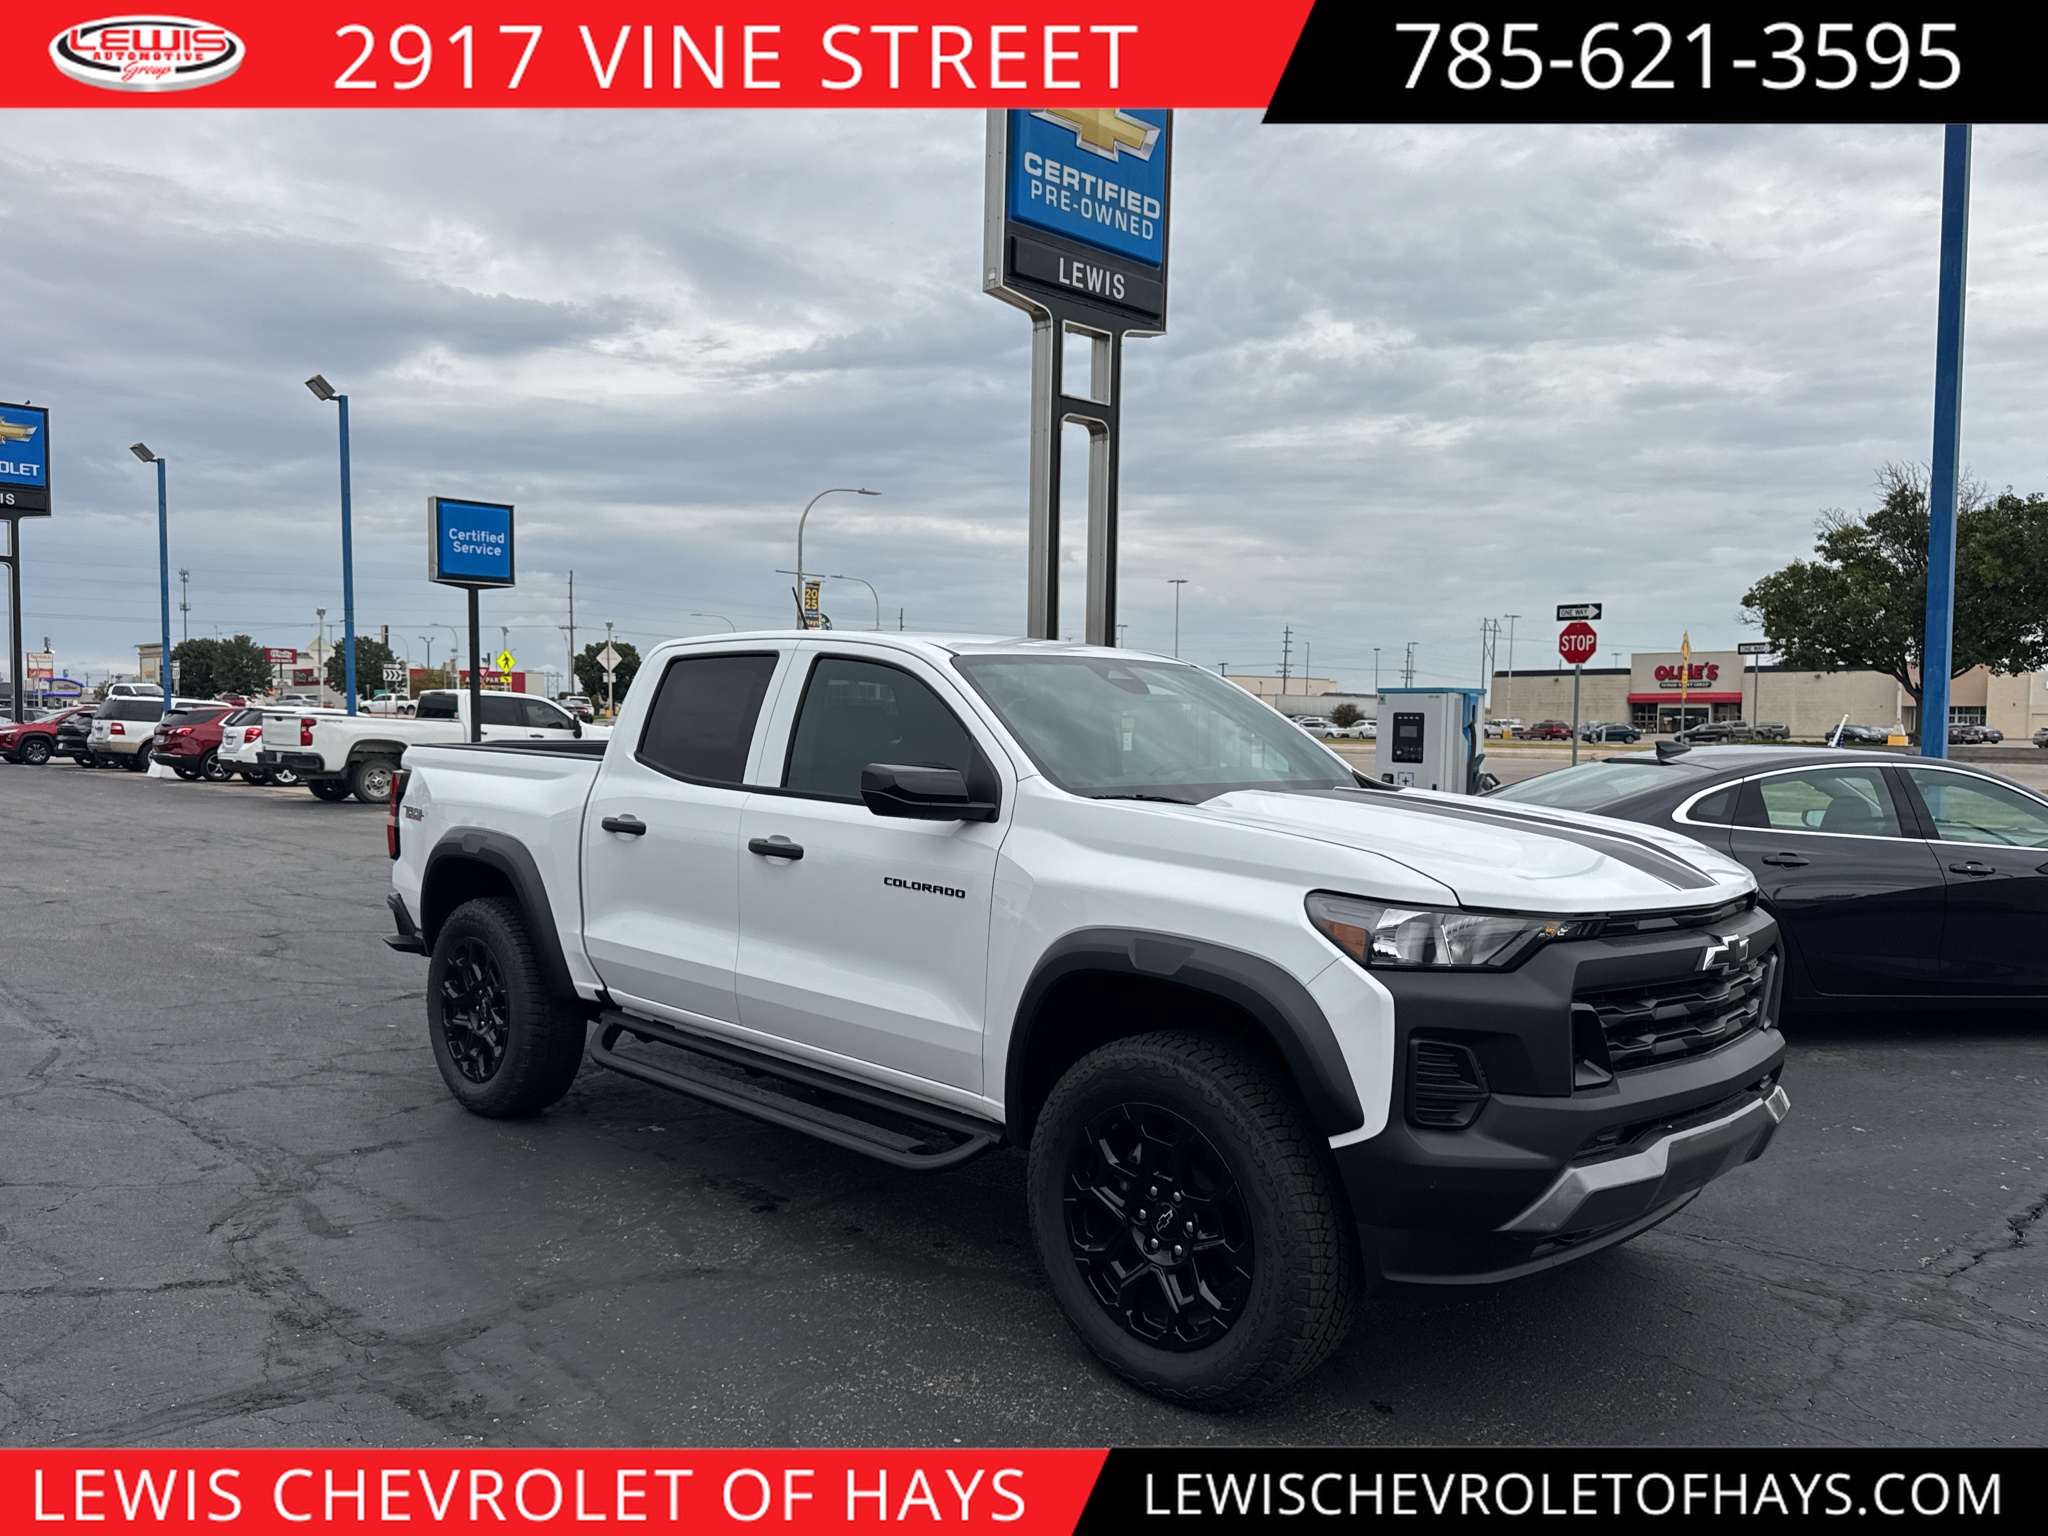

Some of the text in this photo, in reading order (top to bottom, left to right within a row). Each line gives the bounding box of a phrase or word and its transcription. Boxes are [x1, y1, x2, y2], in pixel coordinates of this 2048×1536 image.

[1024, 152, 1160, 220] CERTIFIED
[1031, 179, 1154, 240] PRE-OWNED
[1059, 256, 1125, 300] LEWIS
[448, 527, 505, 544] Certified
[452, 540, 502, 556] Service
[1560, 608, 1588, 617] ONE WAY
[1560, 634, 1595, 652] STOP
[883, 876, 966, 899] COLORADO
